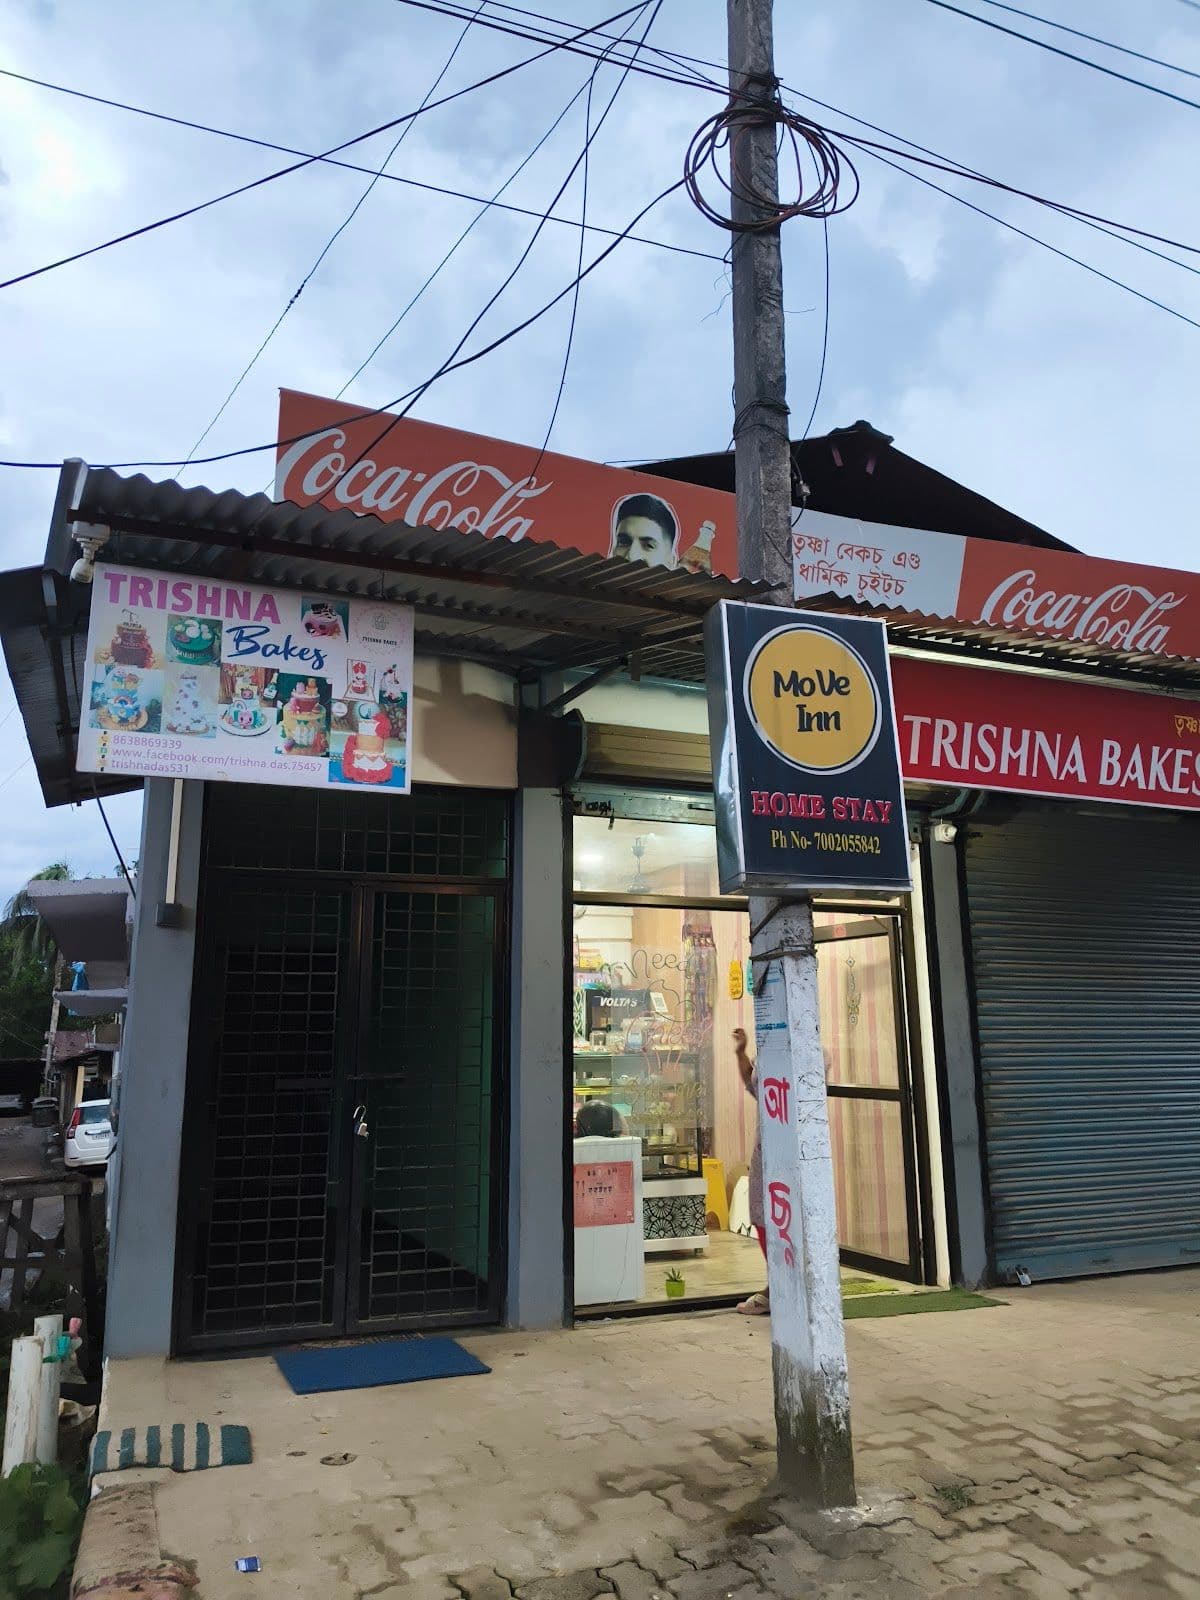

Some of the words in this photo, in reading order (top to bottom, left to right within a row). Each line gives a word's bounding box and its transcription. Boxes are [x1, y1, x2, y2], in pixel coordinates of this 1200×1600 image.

[103, 571, 281, 626] TRISHNA
[225, 624, 328, 670] Bakes
[796, 703, 841, 732] Inn
[112, 733, 182, 749] 8638869339
[903, 715, 1087, 784] TRISHNA
[111, 759, 190, 773] trishnadas531
[751, 791, 826, 820] HOME
[833, 797, 892, 824] STAY
[771, 829, 787, 848] Ph
[814, 831, 881, 854] 7002055842
[600, 997, 638, 1007] VOLTAS
